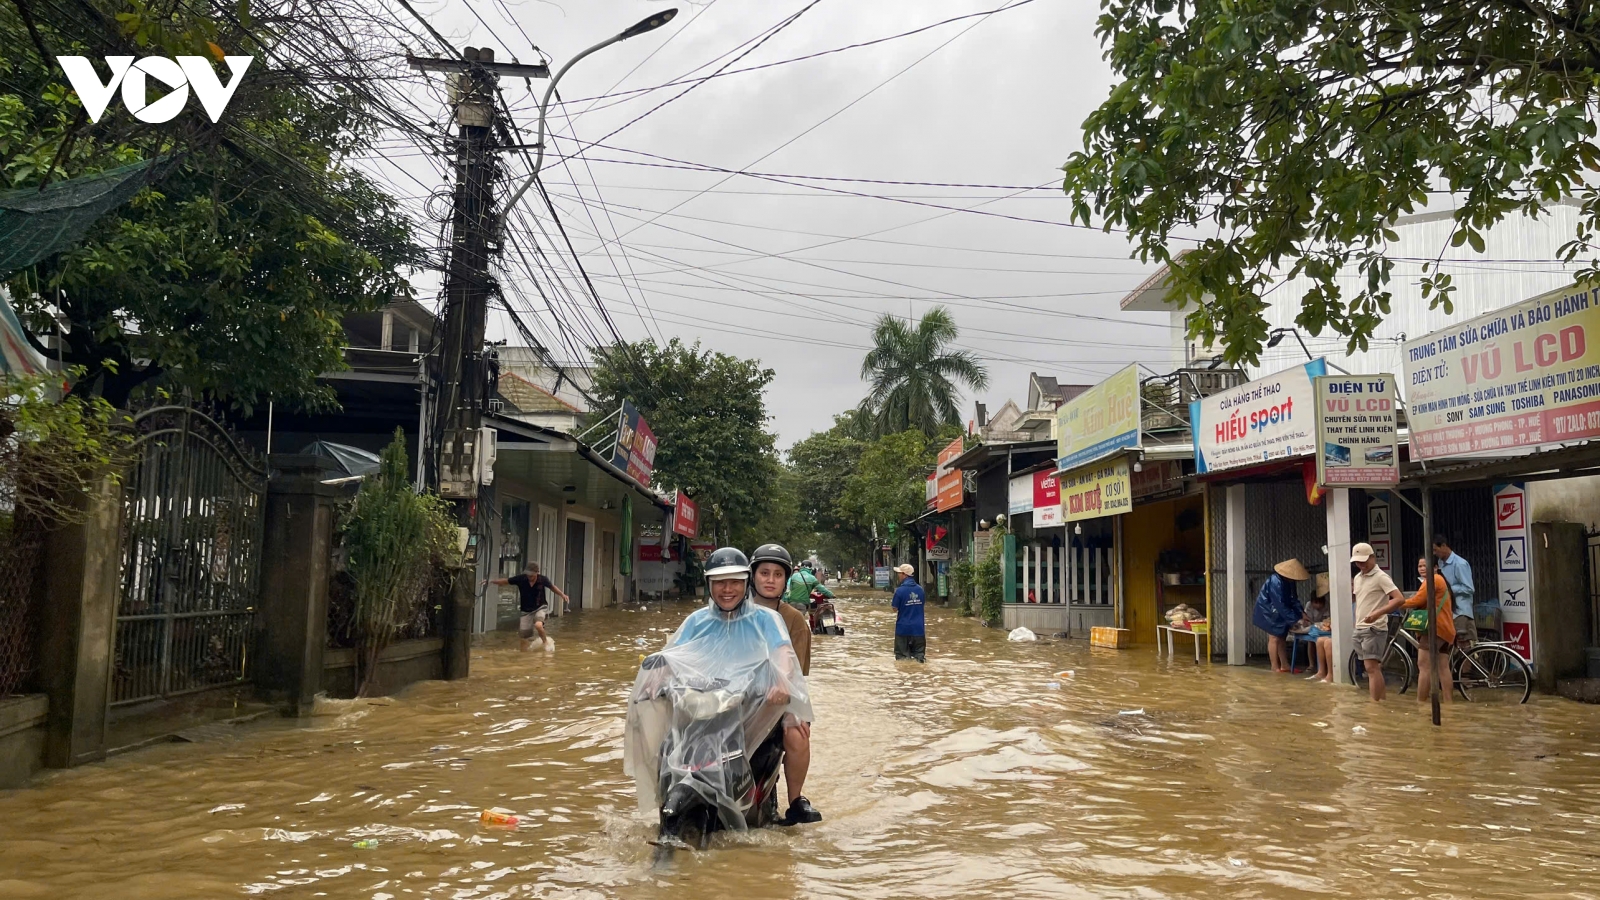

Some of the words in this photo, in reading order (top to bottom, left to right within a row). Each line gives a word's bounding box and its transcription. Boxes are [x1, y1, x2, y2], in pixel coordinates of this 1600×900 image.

[1409, 342, 1436, 362] TRUNG
[1438, 335, 1457, 353] TÂM
[1460, 324, 1478, 346] SỬA
[1480, 317, 1508, 340] CHỮA
[1510, 310, 1525, 331] VÀ
[1528, 301, 1551, 326] BẢO
[1554, 291, 1588, 318] HÀNH
[1461, 342, 1501, 384] VŨ
[1513, 325, 1586, 373] LCD
[1412, 366, 1432, 386] ĐIỆN
[1504, 383, 1517, 396] THAY
[1529, 376, 1541, 391] LINH
[1556, 371, 1567, 386] TIVI
[1576, 368, 1584, 381] 20
[1220, 396, 1232, 410] CỬA
[1233, 393, 1250, 405] HÀNG
[1252, 383, 1262, 399] THỂ
[1263, 383, 1281, 396] THAO
[1329, 381, 1363, 395] ĐIỆN
[1367, 378, 1385, 393] TỬ
[1106, 386, 1132, 429] Huệ
[1326, 396, 1350, 412] VŨ
[1356, 399, 1391, 412] LCD
[1447, 410, 1464, 423] SONY
[1469, 406, 1484, 418] SAM
[1486, 401, 1505, 415] SUNG
[1511, 394, 1545, 411] TOSHIBA
[1215, 409, 1247, 443] HIẾU
[1250, 396, 1293, 432] sport
[1324, 415, 1351, 423] CHUYÊN
[1353, 413, 1367, 422] SỬA
[1383, 414, 1393, 422] VÀ
[1528, 412, 1542, 428] HUẾ
[1567, 413, 1587, 433] ZALO:
[1345, 424, 1357, 433] THẾ
[1377, 425, 1393, 434] KIỆN
[1529, 428, 1542, 442] HUẾ
[1338, 436, 1359, 444] CHÍNH
[1106, 482, 1113, 497] CƠ
[1114, 478, 1121, 496] SỞ
[1069, 493, 1084, 514] KIM
[1084, 483, 1102, 514] HUỆ
[1502, 503, 1516, 513] NIKE
